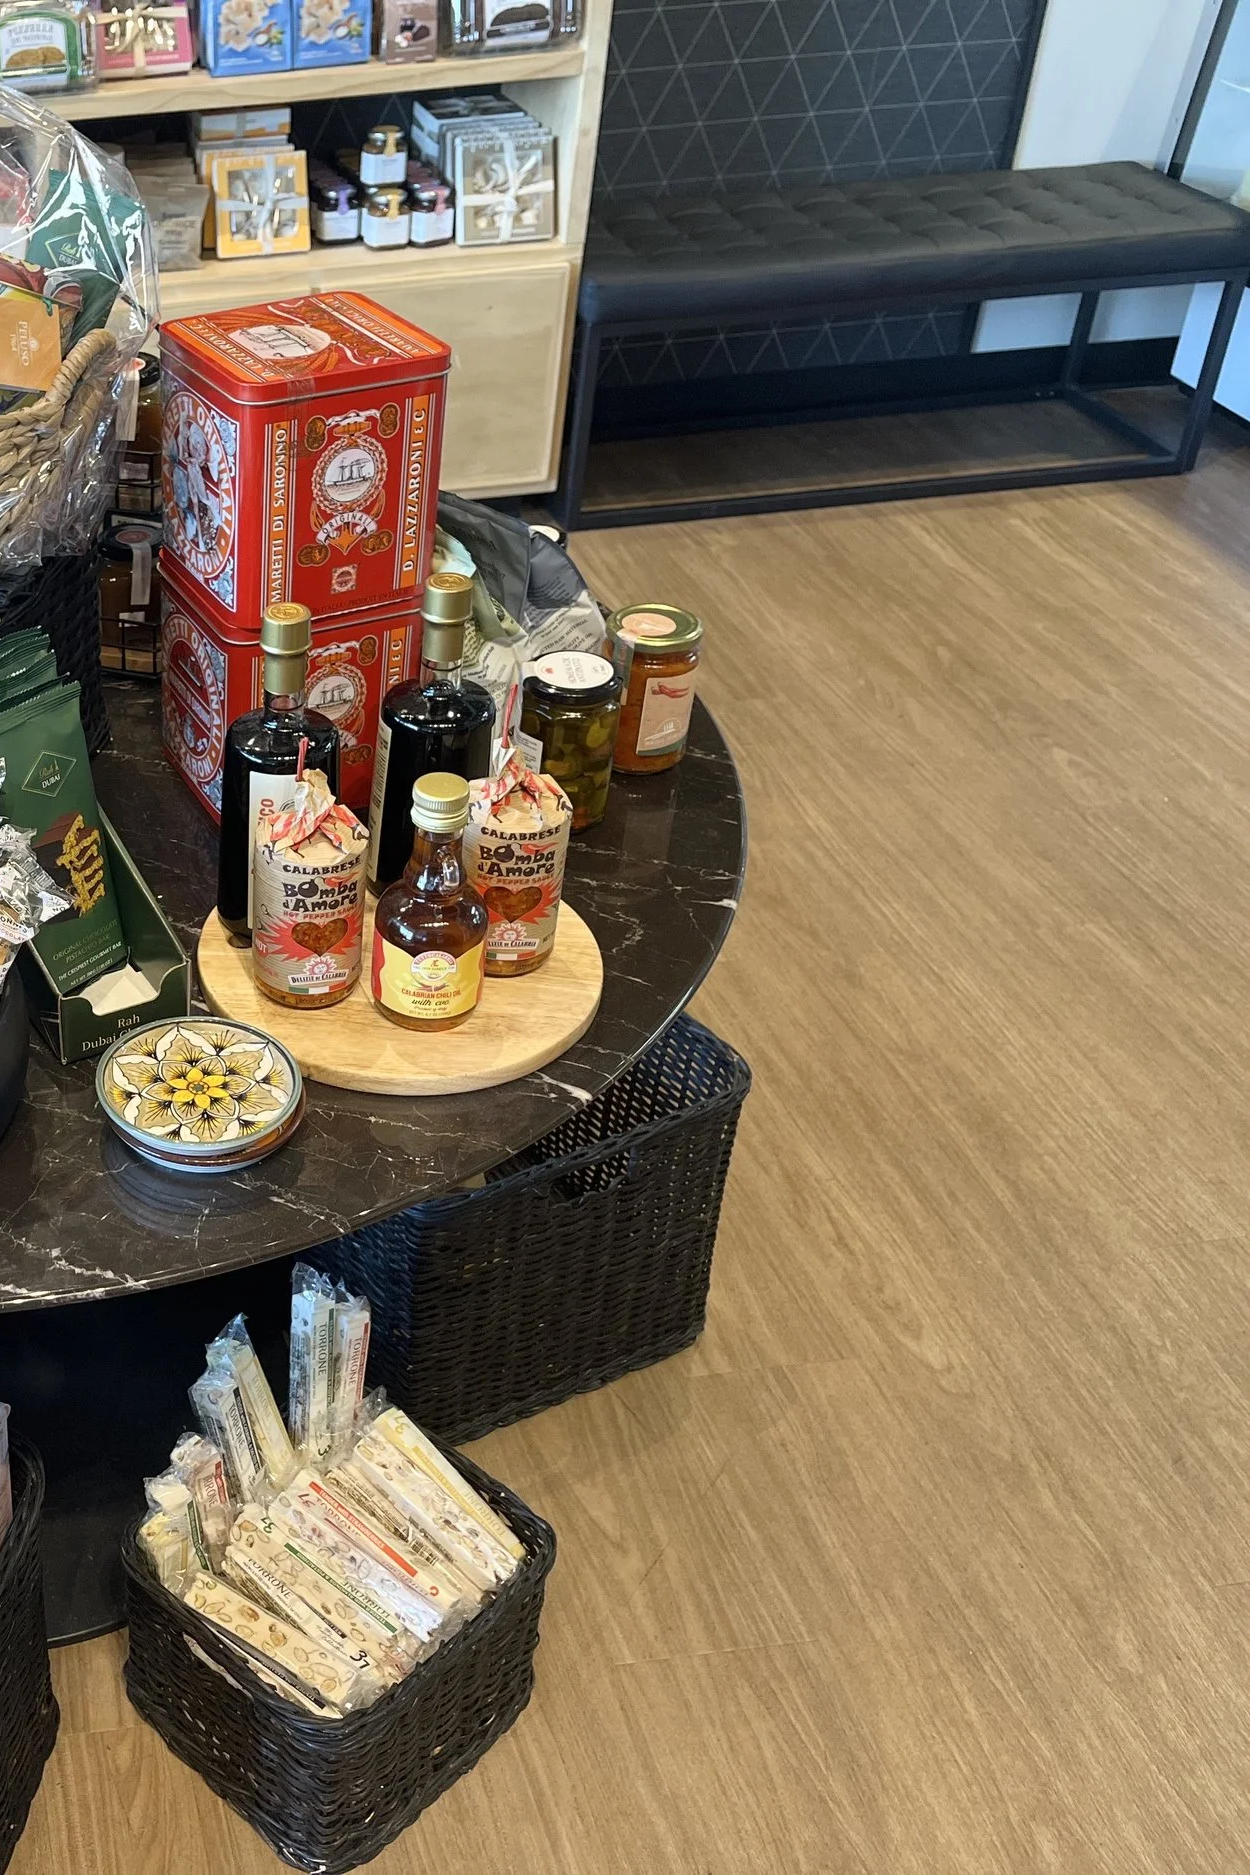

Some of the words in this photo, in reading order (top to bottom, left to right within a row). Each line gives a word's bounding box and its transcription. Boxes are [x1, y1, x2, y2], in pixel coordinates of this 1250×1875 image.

[18, 321, 31, 367] PELUSO
[207, 332, 263, 372] LAZZARONI
[414, 408, 427, 422] C
[273, 428, 288, 508] SARONNO
[403, 440, 423, 549] LAZZARONI
[272, 514, 285, 532] DI
[322, 512, 375, 536] ORIGINALI
[270, 538, 285, 603] MARETTI
[402, 553, 415, 573] D.
[41, 773, 62, 789] DUBAI
[480, 826, 562, 841] CALABRESE
[282, 855, 361, 875] CALABRESE
[477, 860, 555, 878] d'Amore
[282, 892, 359, 913] d'Amore
[52, 939, 82, 961] ORIGINAL
[65, 941, 99, 964] PISTACHIO
[58, 973, 68, 982] THE
[67, 959, 90, 976] CRISPIEST
[89, 948, 112, 964] GOURMET
[110, 940, 123, 951] BAR
[321, 970, 347, 981] CALABRIA
[401, 988, 435, 999] CALABRIAN
[411, 998, 432, 1006] with
[117, 1015, 140, 1029] Rah
[82, 1035, 116, 1052] Dubai
[318, 1322, 328, 1377] TORRONE
[349, 1337, 363, 1385] TORRONE
[228, 1404, 246, 1446] TORRONE
[203, 1478, 219, 1507] RRONE
[260, 1516, 276, 1534] 37
[349, 1650, 371, 1669] 37
